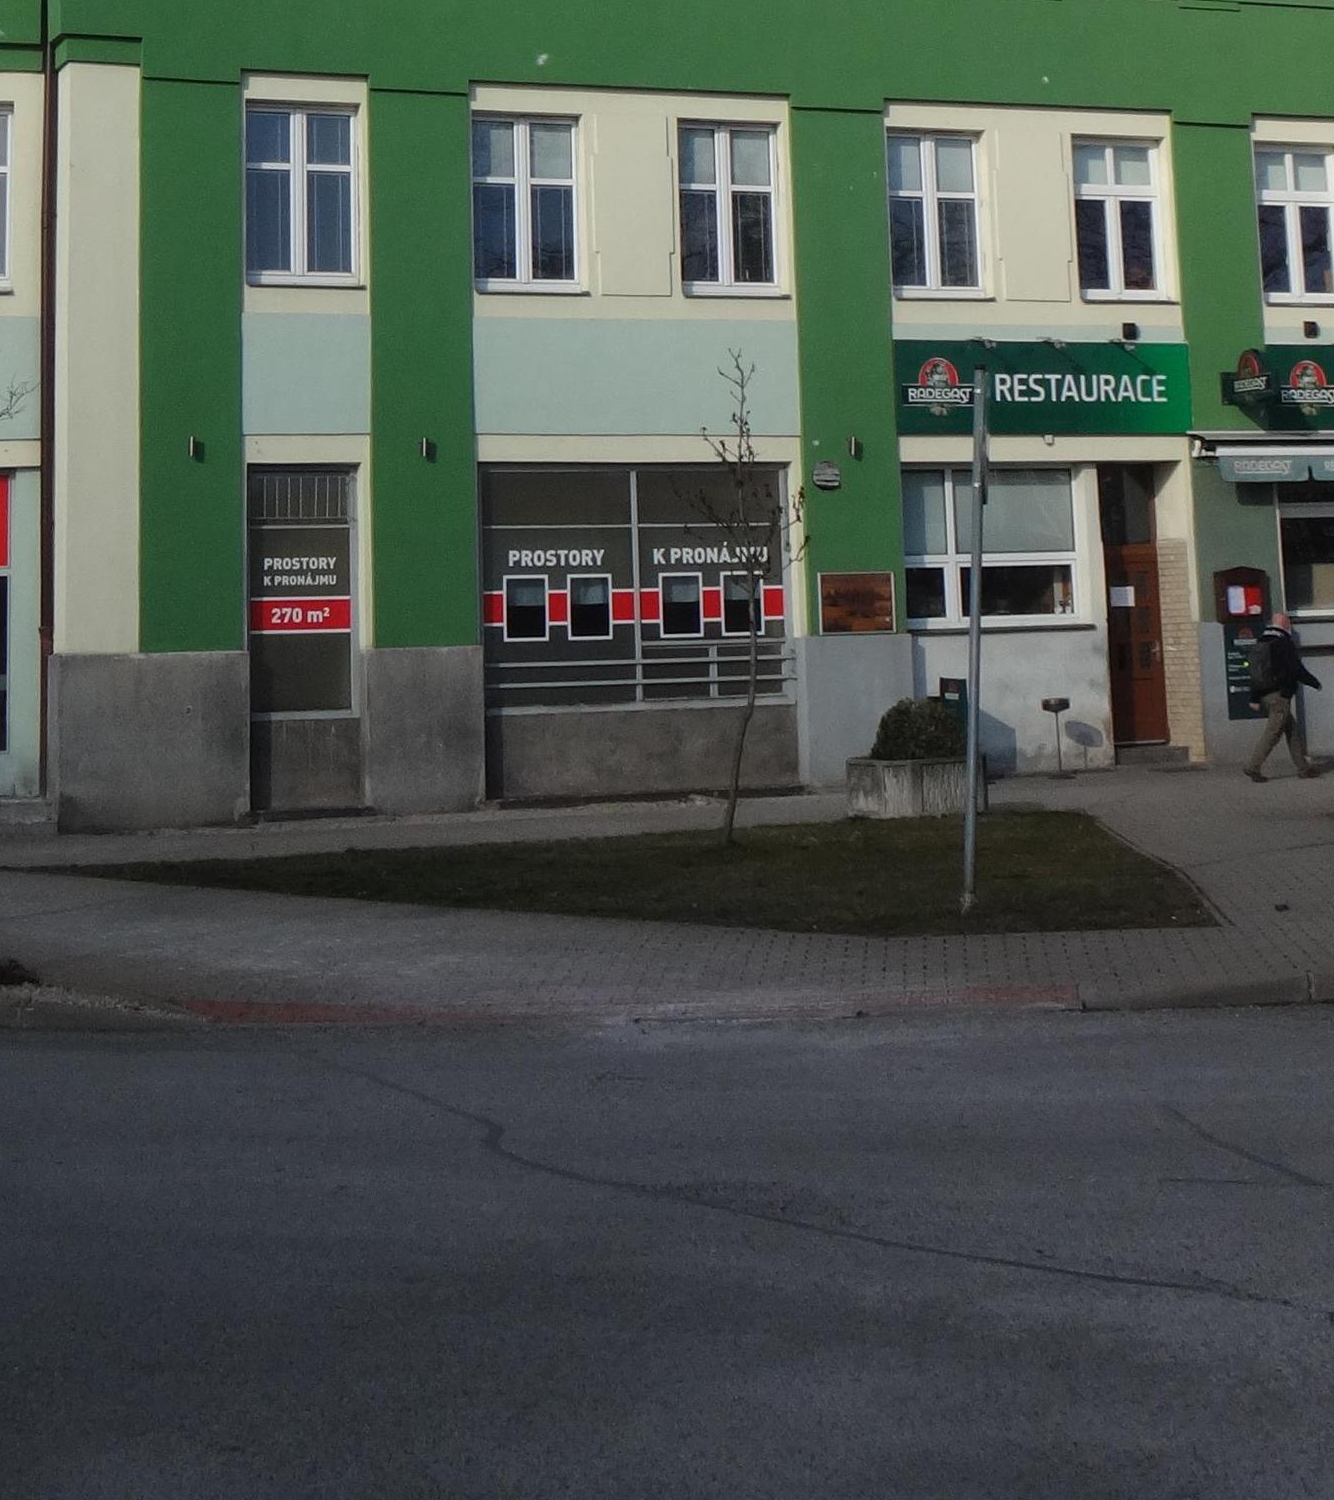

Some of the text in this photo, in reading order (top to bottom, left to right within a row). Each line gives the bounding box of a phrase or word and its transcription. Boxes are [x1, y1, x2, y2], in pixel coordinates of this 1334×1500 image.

[908, 387, 973, 404] RADEGAST
[994, 373, 1168, 403] RESTAURACE
[263, 557, 336, 570] PROSTORY
[508, 549, 604, 567] PROSTORY
[653, 548, 666, 565] K
[263, 572, 337, 586] K PRONÁJMU
[271, 606, 330, 623] 270 m²
